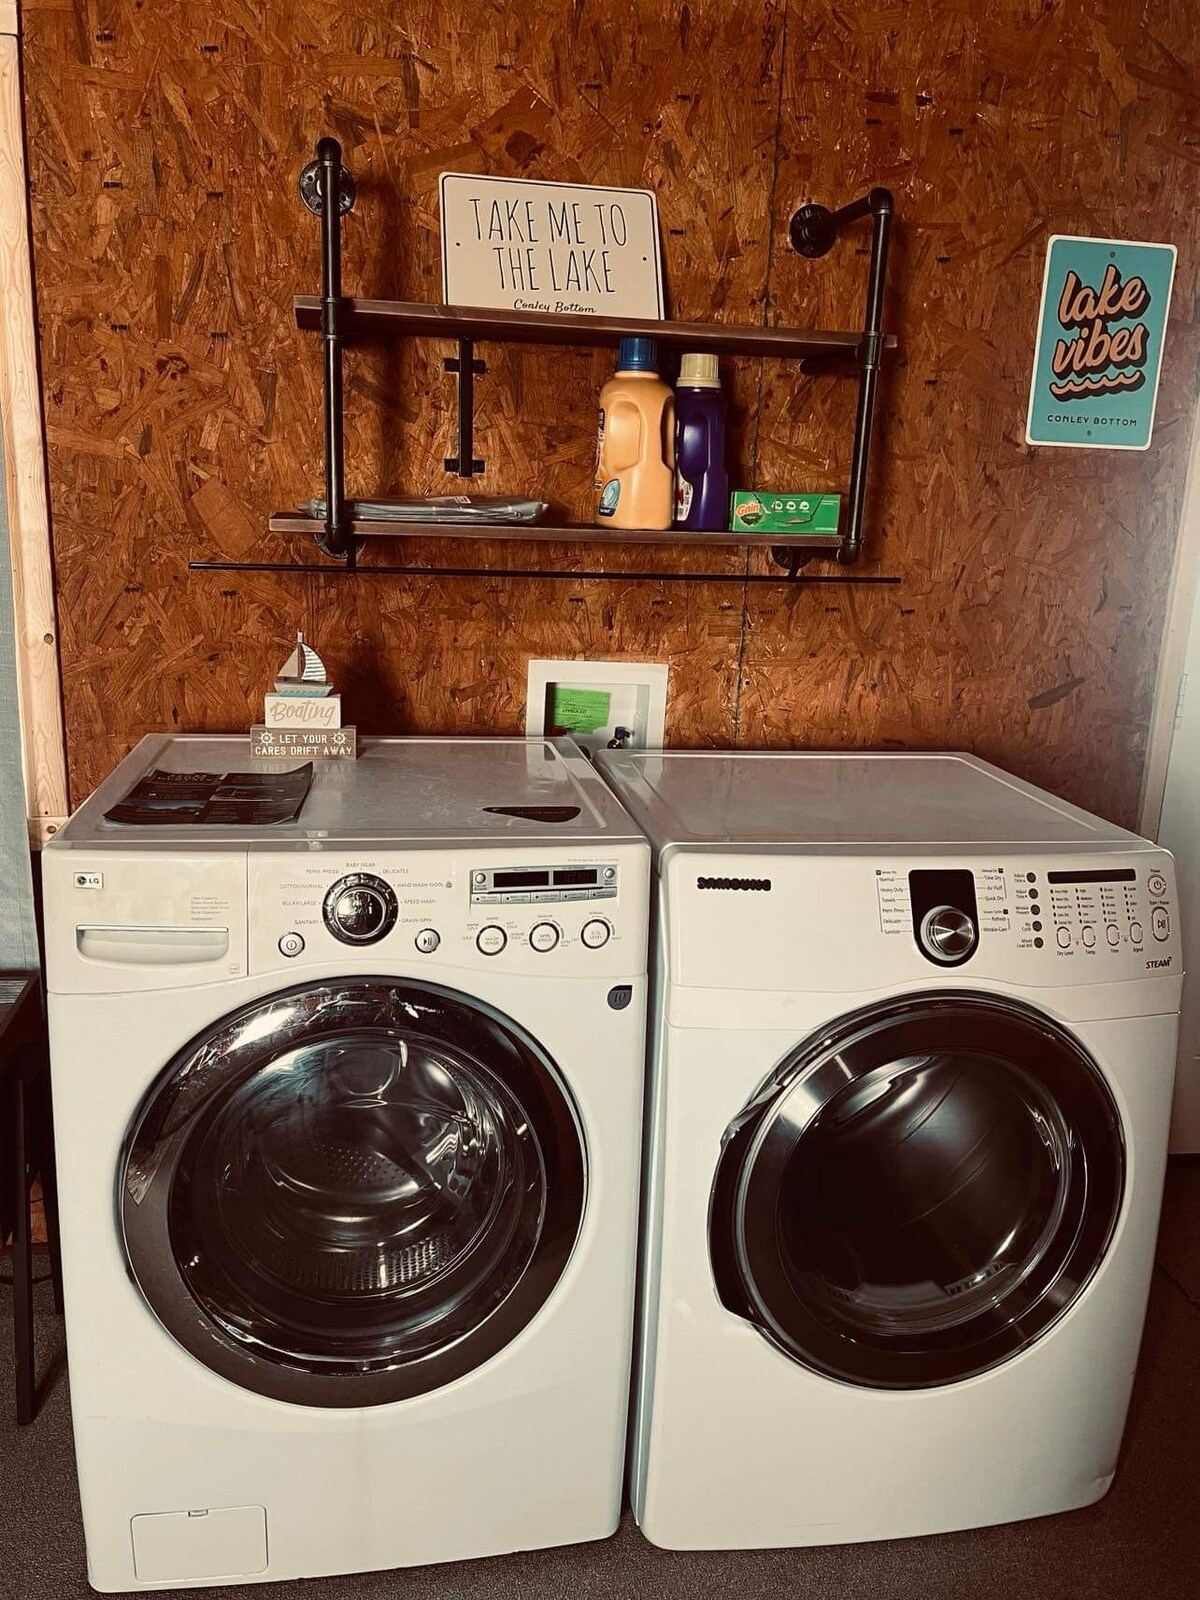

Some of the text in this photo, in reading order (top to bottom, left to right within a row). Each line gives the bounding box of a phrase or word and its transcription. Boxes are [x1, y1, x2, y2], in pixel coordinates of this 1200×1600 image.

[469, 199, 627, 247] TAKE ME TO
[493, 248, 615, 293] THE LAKE
[1058, 264, 1150, 329] lake
[513, 299, 597, 313] Conley Bottom
[1052, 320, 1149, 379] vibes
[1047, 414, 1137, 426] CONLEY BOTTOM
[736, 502, 762, 516] Gain
[270, 700, 336, 726] Boating
[279, 734, 327, 744] LET YOUR
[255, 746, 352, 756] CARES DRIFT AWAY
[88, 877, 100, 885] LG
[1145, 958, 1170, 969] STEAM
